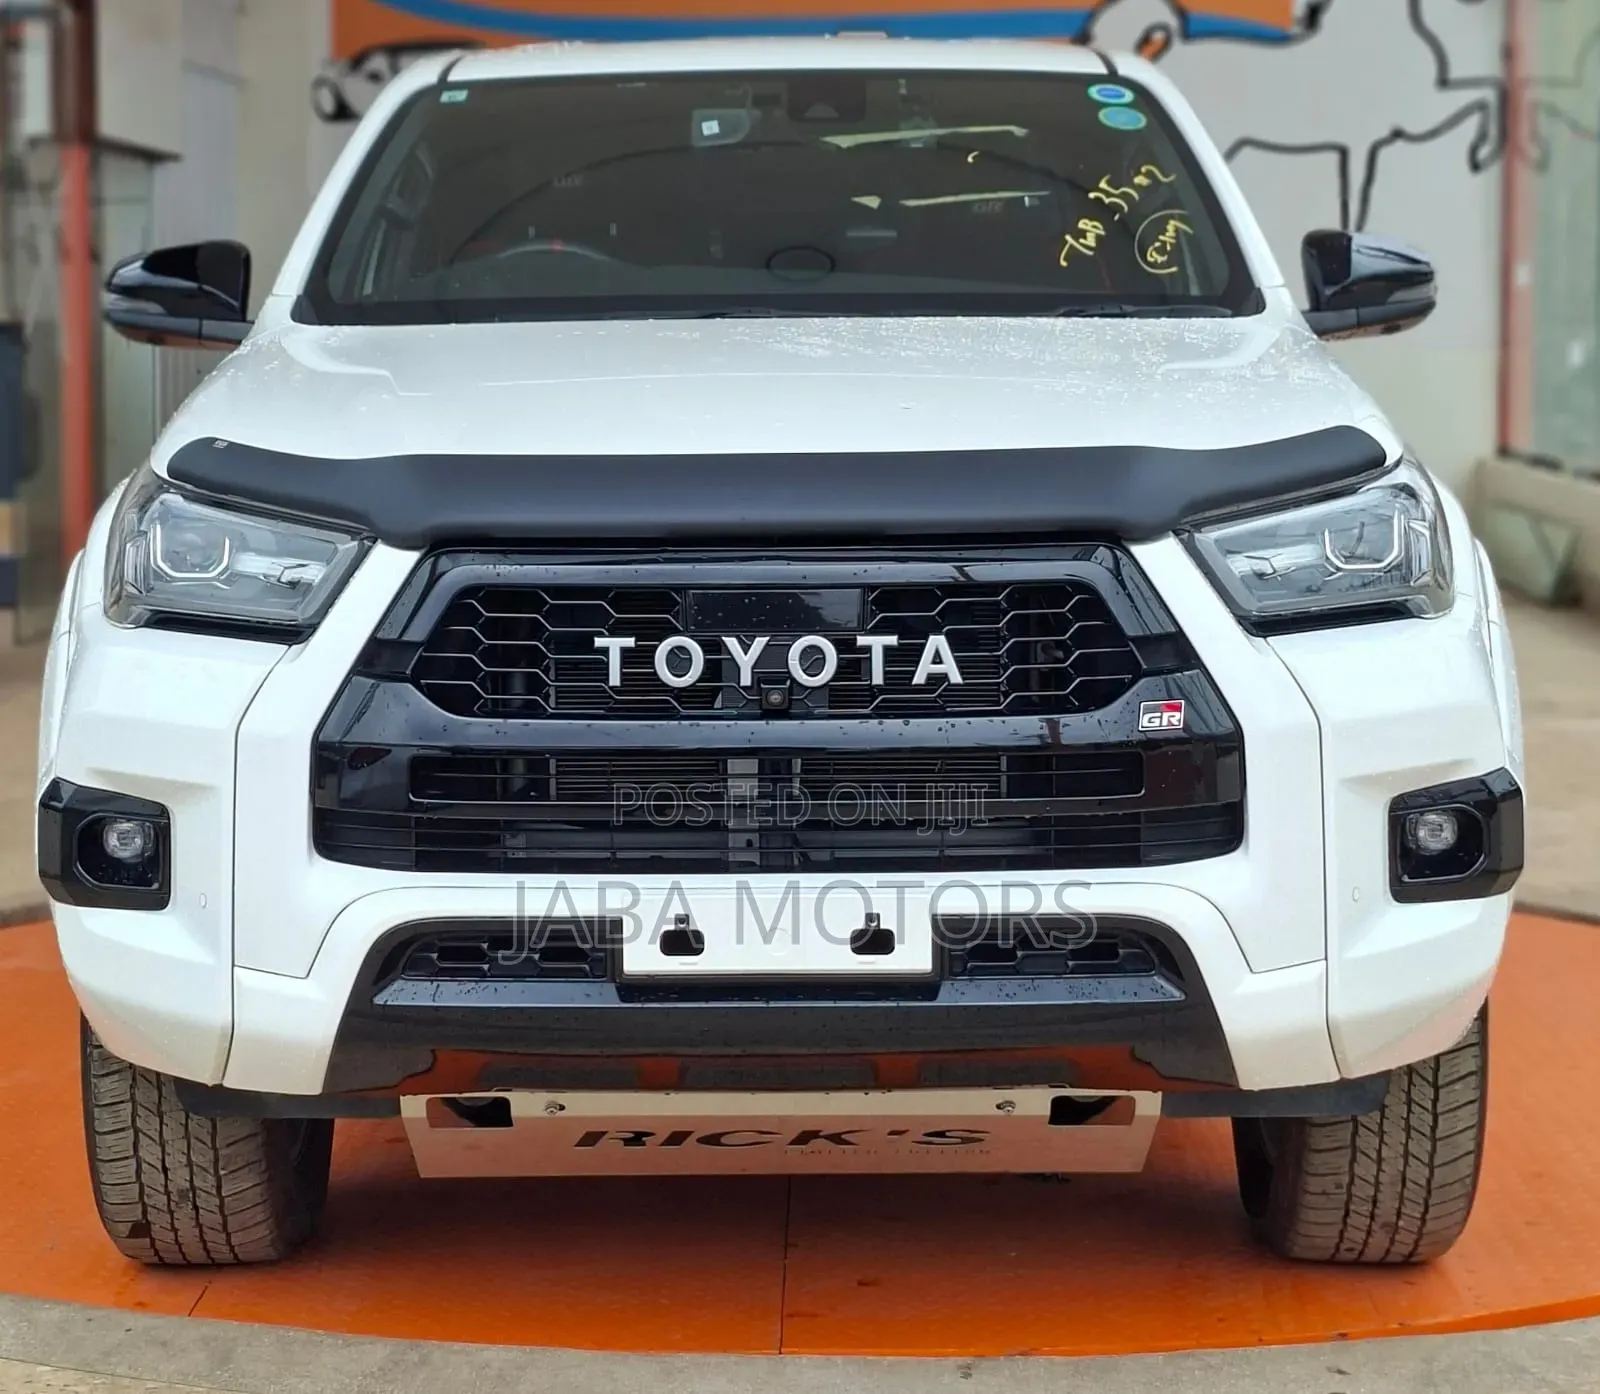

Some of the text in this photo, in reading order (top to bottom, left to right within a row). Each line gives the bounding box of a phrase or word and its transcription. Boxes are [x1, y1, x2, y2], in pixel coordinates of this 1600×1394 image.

[594, 634, 964, 688] TOYOTA
[1142, 711, 1182, 728] GR
[573, 1129, 991, 1148] RICK'S
